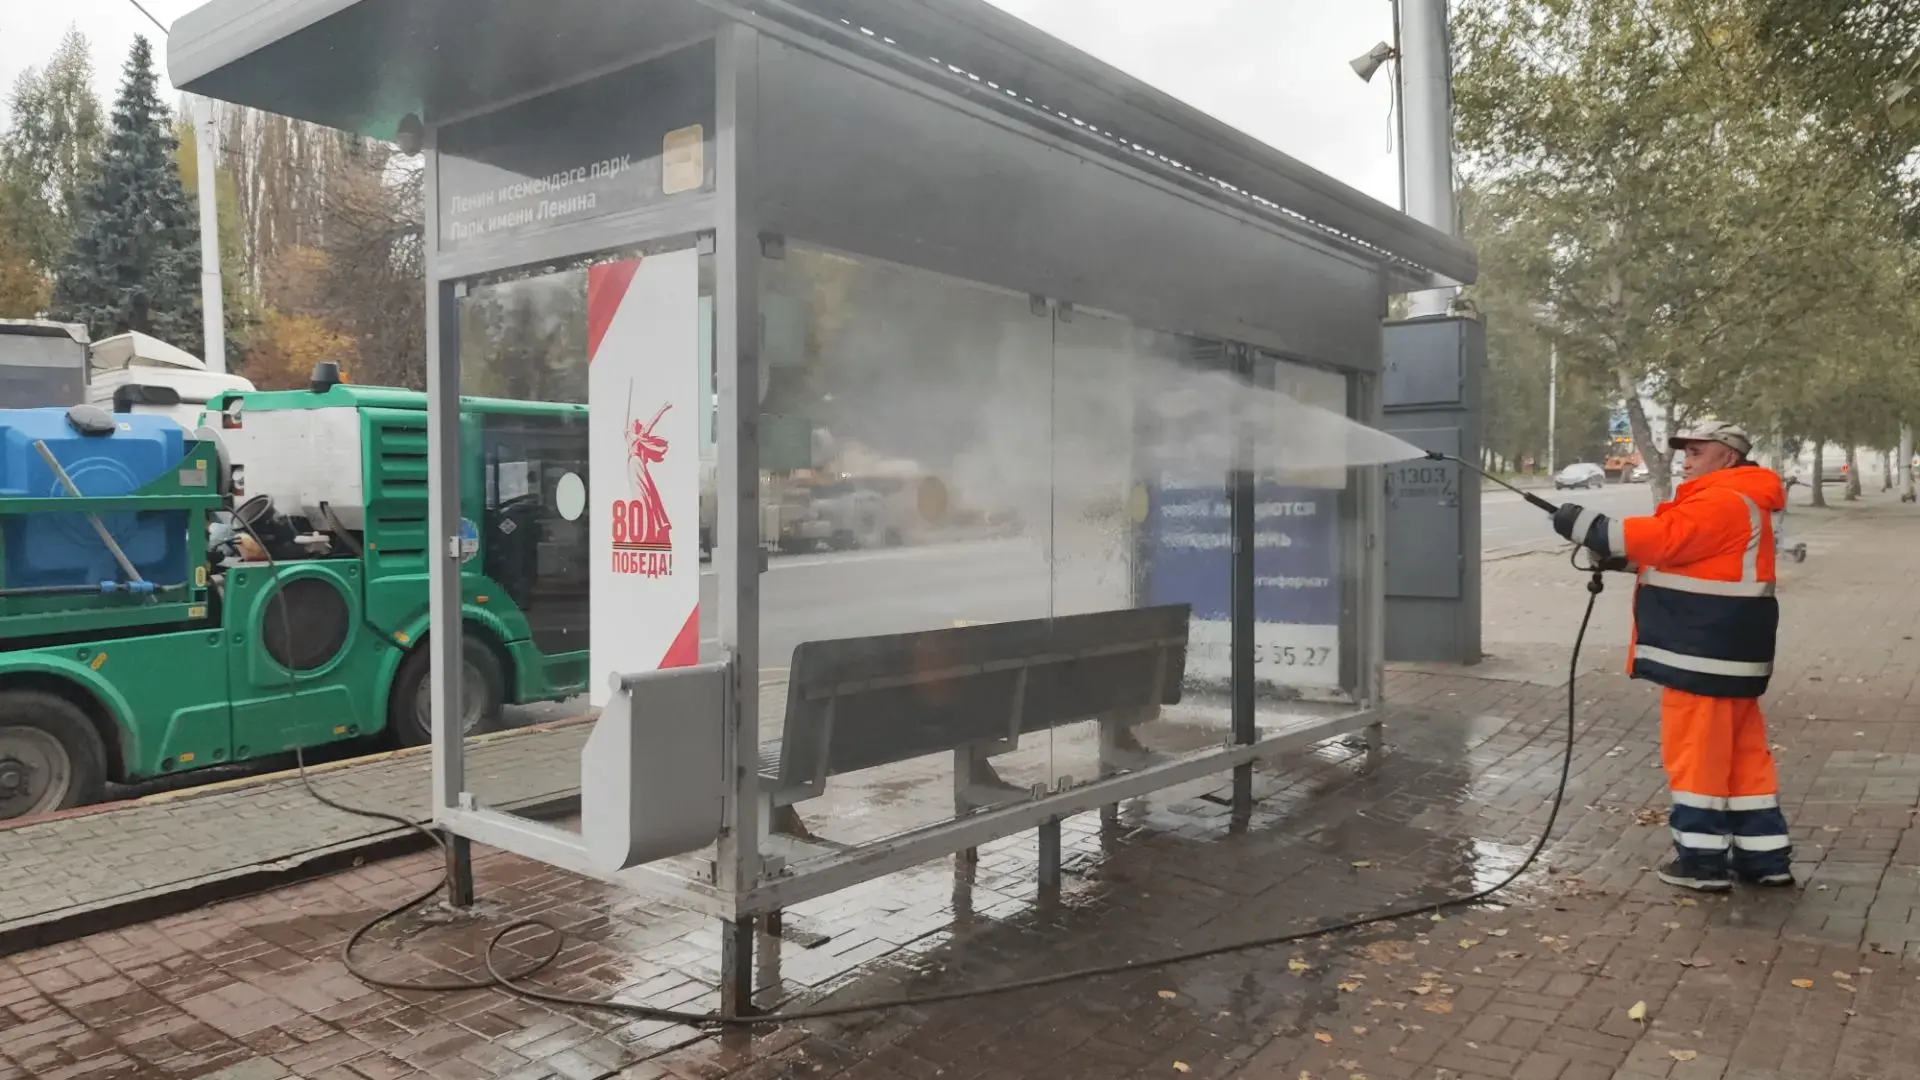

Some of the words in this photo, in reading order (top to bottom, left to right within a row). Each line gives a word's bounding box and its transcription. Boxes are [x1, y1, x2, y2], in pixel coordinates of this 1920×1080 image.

[450, 189, 495, 216] Ленин
[498, 167, 587, 201] исемендаге
[590, 153, 632, 179] парк
[450, 215, 485, 240] Парк
[488, 204, 533, 230] имени
[537, 191, 597, 221] Ленина
[612, 500, 643, 543] 80
[612, 552, 672, 578] ПОБЕДА!
[1302, 646, 1332, 667] 27
